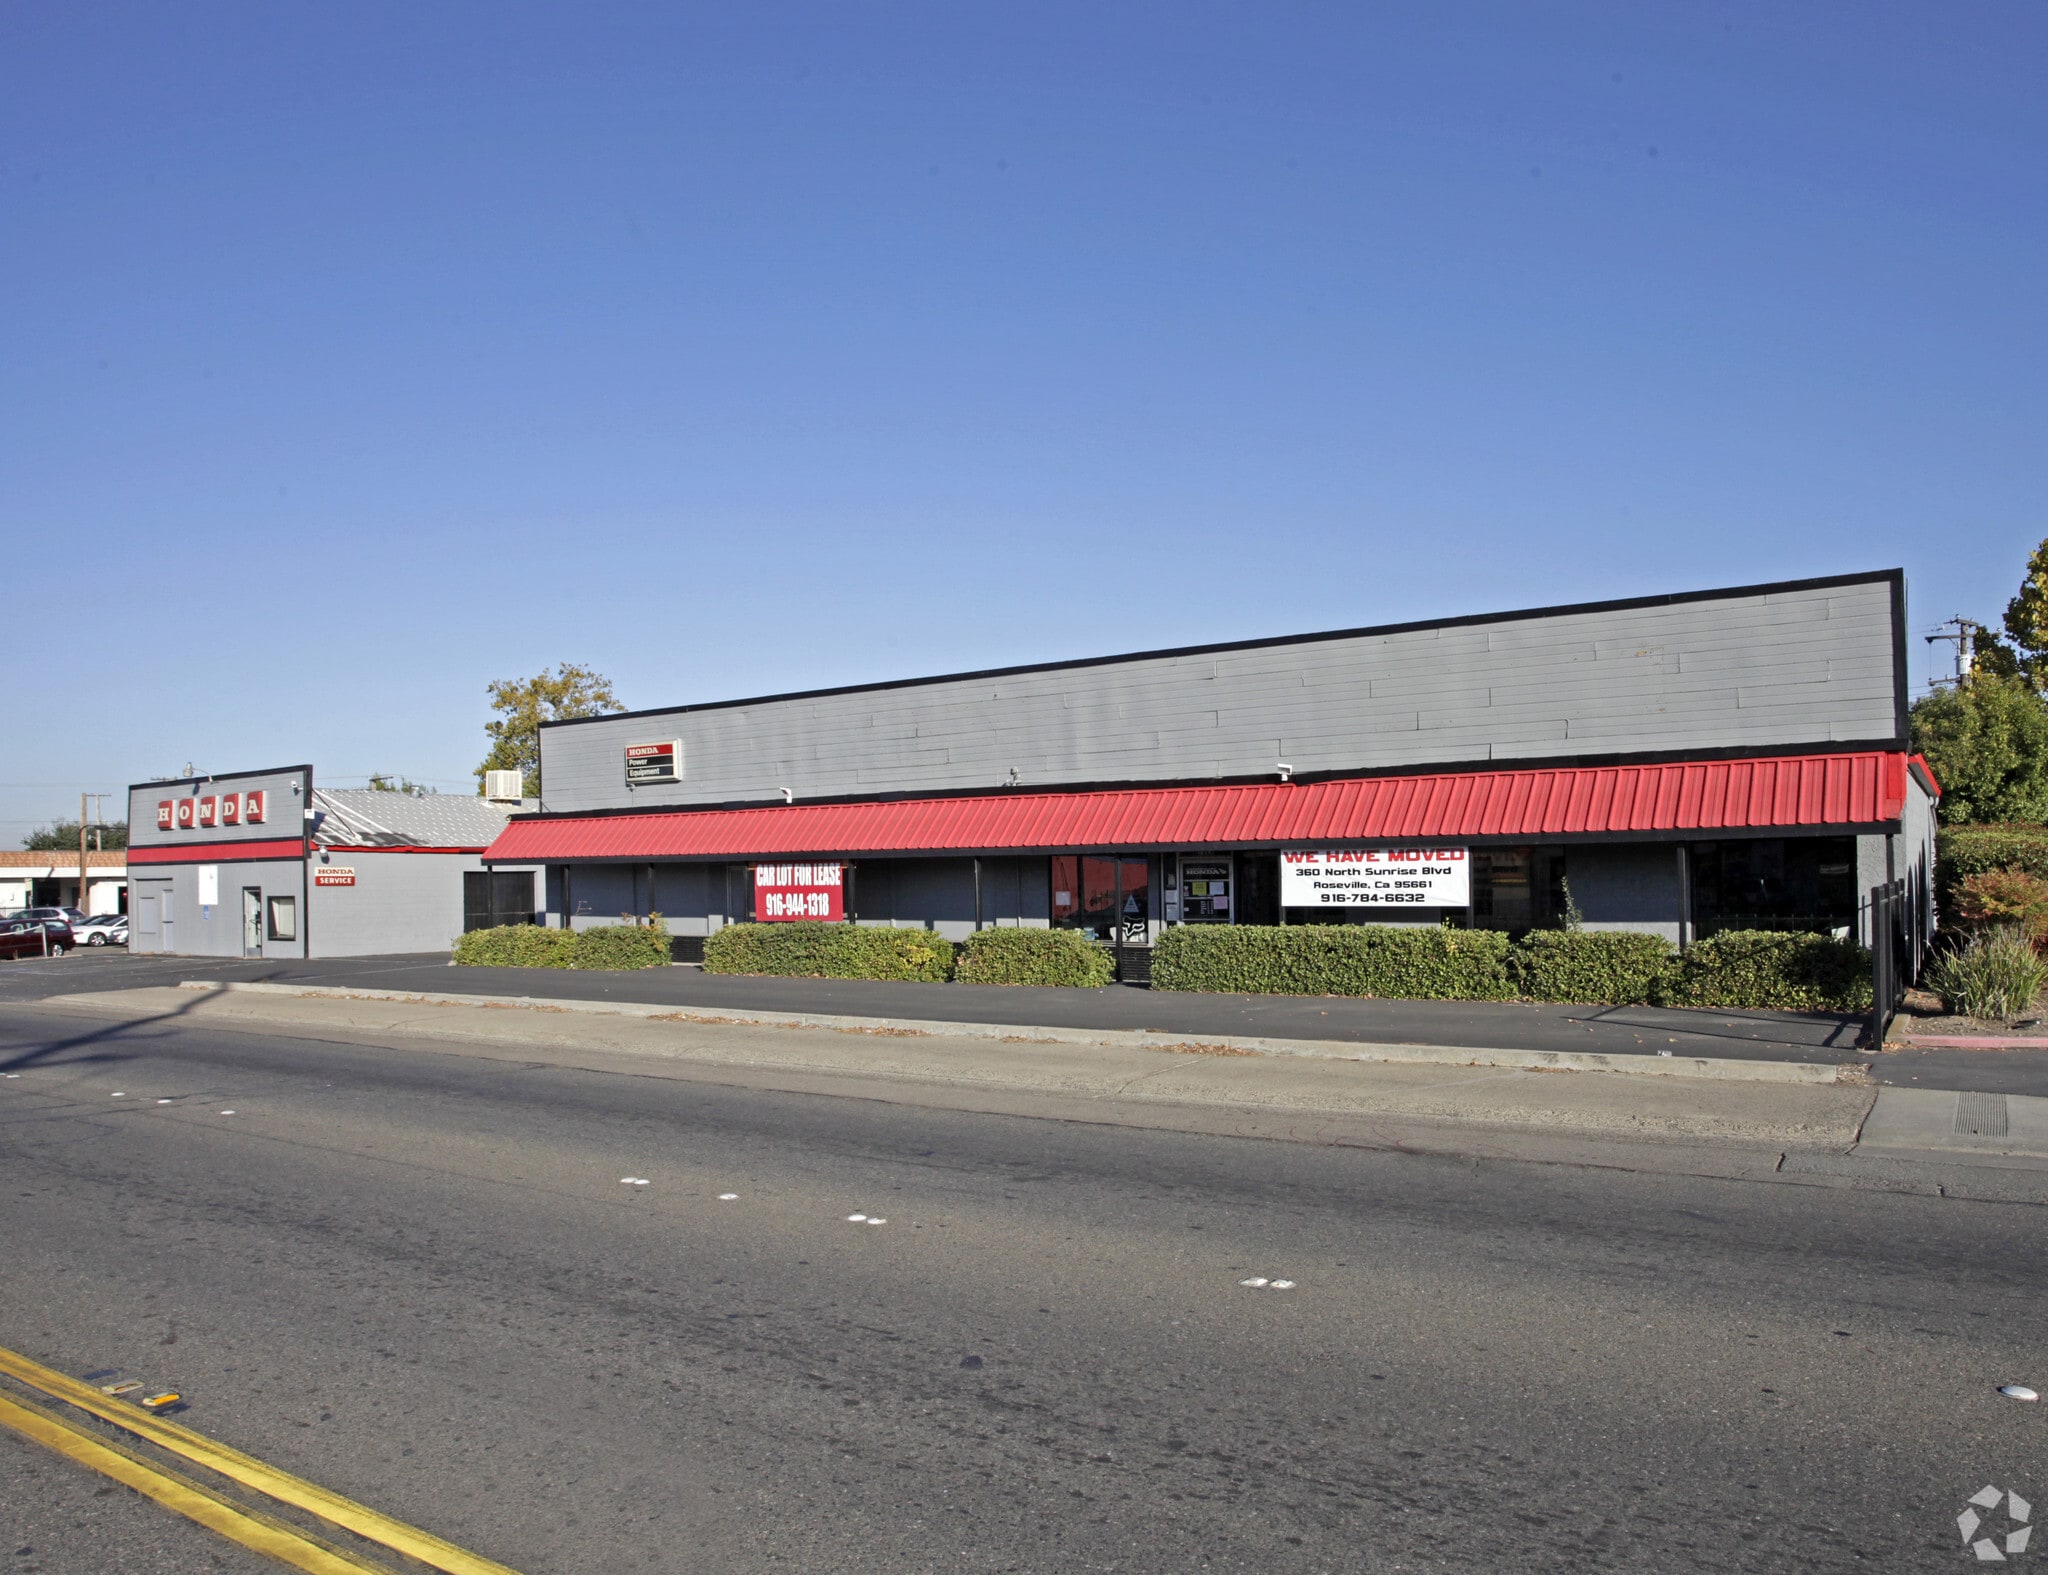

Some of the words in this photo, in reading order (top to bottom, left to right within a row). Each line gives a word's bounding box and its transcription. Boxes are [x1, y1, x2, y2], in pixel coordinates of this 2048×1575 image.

[629, 747, 659, 756] HONDA
[629, 768, 660, 777] Equipment
[158, 799, 260, 822] HONDA
[1283, 851, 1320, 863] WE
[1326, 850, 1380, 863] HAVE
[1388, 848, 1465, 861] MOVED
[756, 863, 776, 886] CAR
[777, 863, 793, 886] LOT
[794, 863, 812, 886] FOR
[813, 863, 841, 886] LEASE
[1296, 868, 1320, 876] 360
[1325, 867, 1361, 876] North
[1365, 867, 1417, 875] Sunrise
[1422, 866, 1452, 875] Blvd
[1313, 881, 1371, 889] Roseville,
[1374, 881, 1390, 889] Ca
[1321, 893, 1426, 903] 916-784-6632
[765, 892, 830, 916] 916-944-1318
